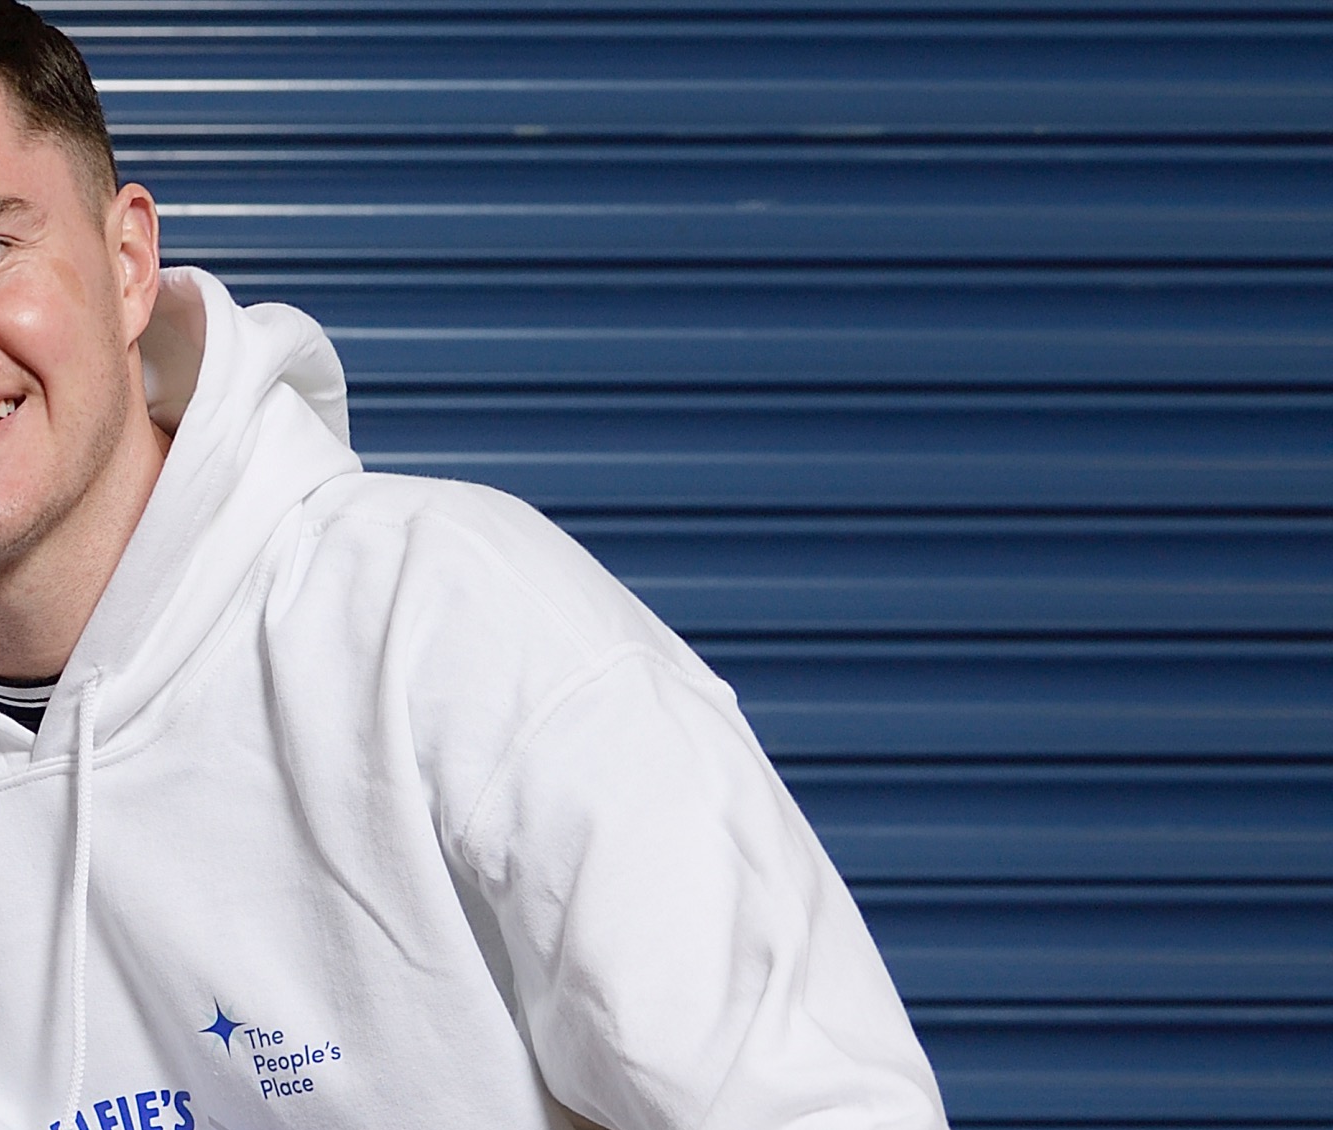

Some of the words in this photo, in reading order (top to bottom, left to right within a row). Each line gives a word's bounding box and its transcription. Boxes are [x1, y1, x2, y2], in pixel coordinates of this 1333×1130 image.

[244, 1027, 284, 1049] The
[253, 1041, 341, 1075] People's
[260, 1077, 314, 1100] Place
